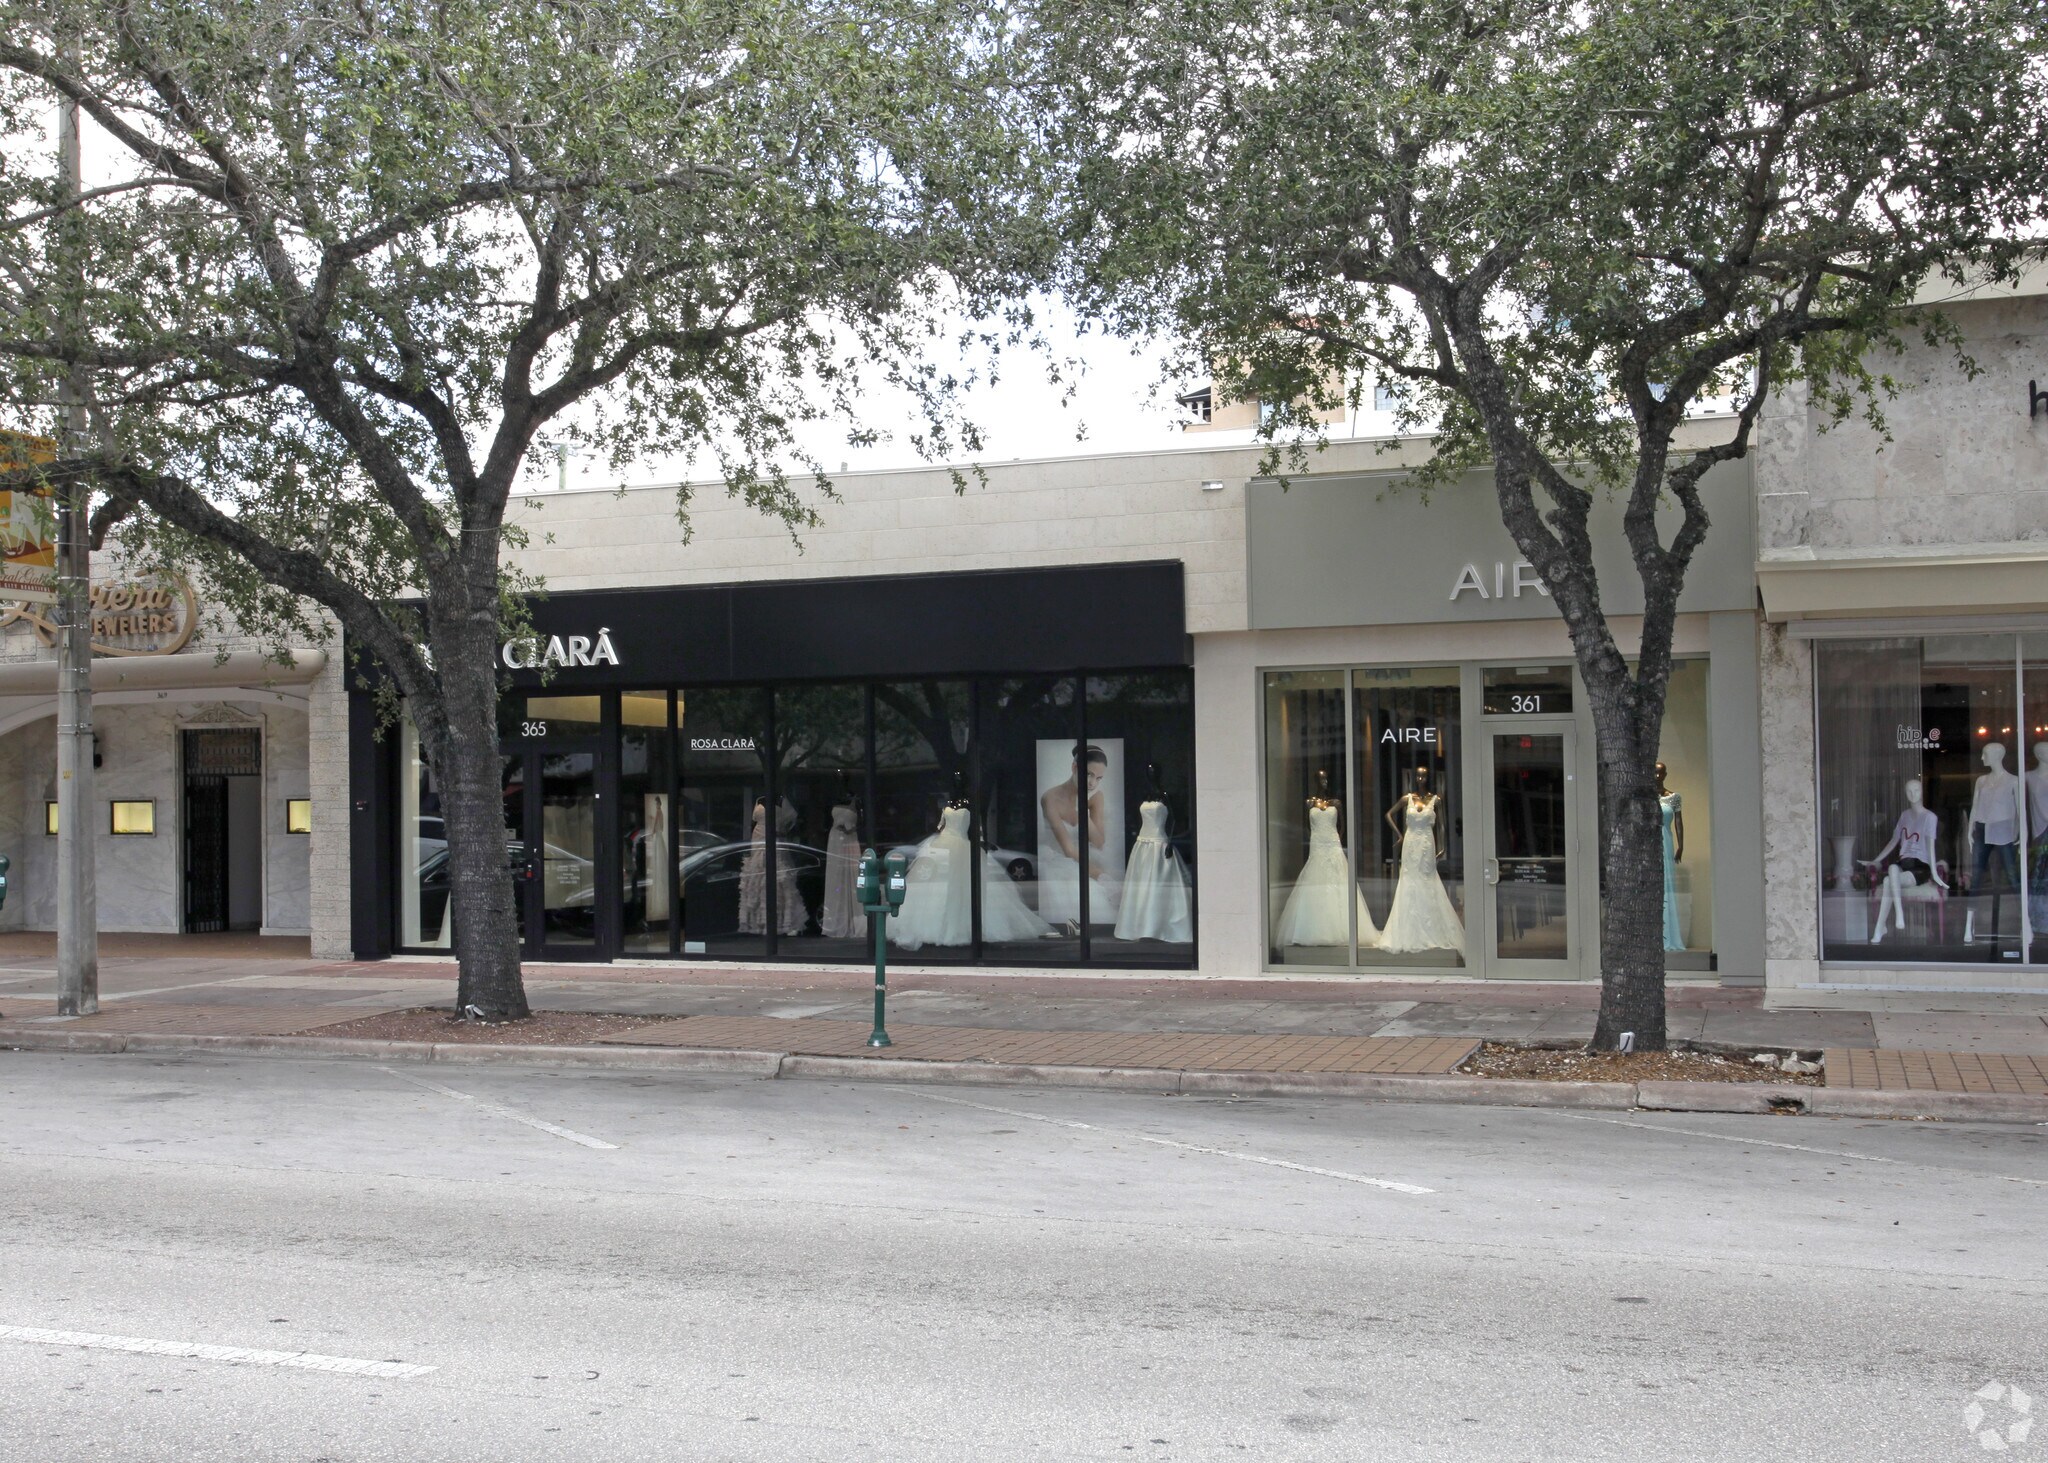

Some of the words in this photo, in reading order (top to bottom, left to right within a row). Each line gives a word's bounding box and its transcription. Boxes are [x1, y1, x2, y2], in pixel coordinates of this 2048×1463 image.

[1449, 561, 1550, 600] AIR
[91, 612, 176, 636] EWELERS
[1511, 696, 1541, 712] 361
[521, 722, 547, 737] 365
[1381, 727, 1437, 743] AIRE
[691, 738, 719, 749] ROSA
